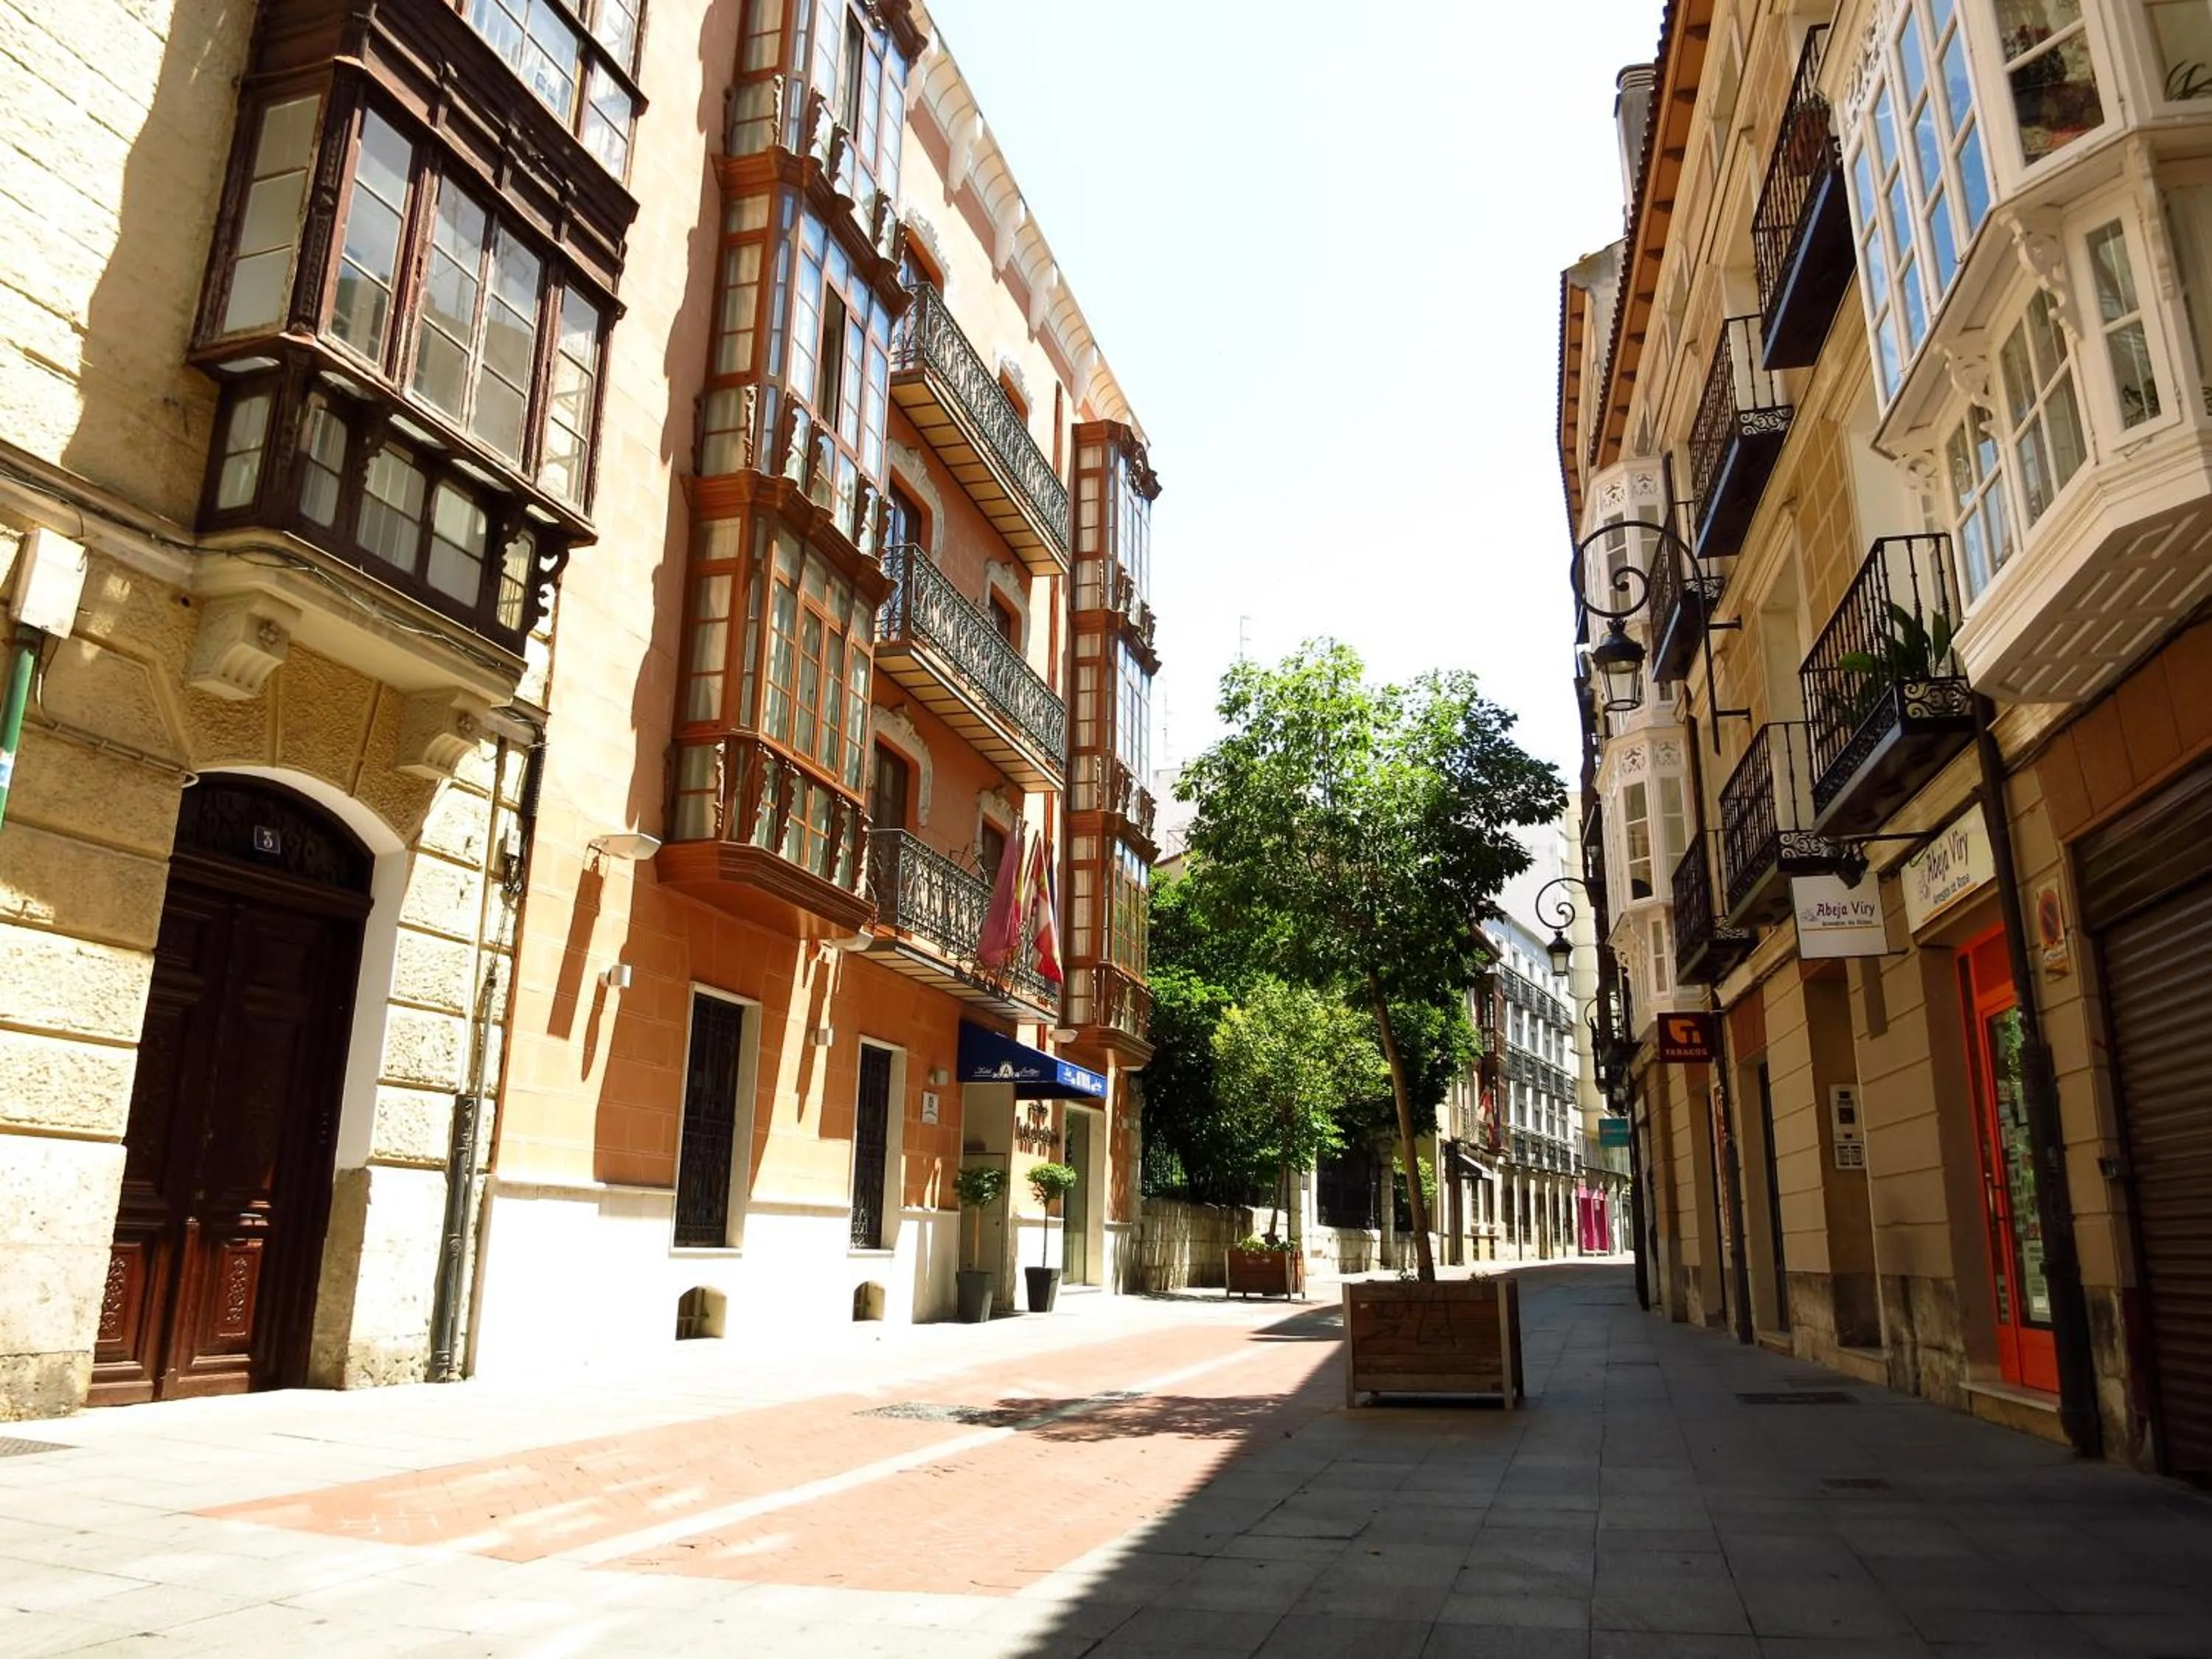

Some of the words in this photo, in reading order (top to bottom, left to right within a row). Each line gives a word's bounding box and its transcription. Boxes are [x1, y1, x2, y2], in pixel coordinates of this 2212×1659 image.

[1925, 843, 1950, 884] Abeja
[1947, 830, 1968, 866] Viry
[1816, 902, 1848, 919] Abeja
[1851, 900, 1875, 918] Viry
[1666, 1048, 1708, 1056] TABACOS
